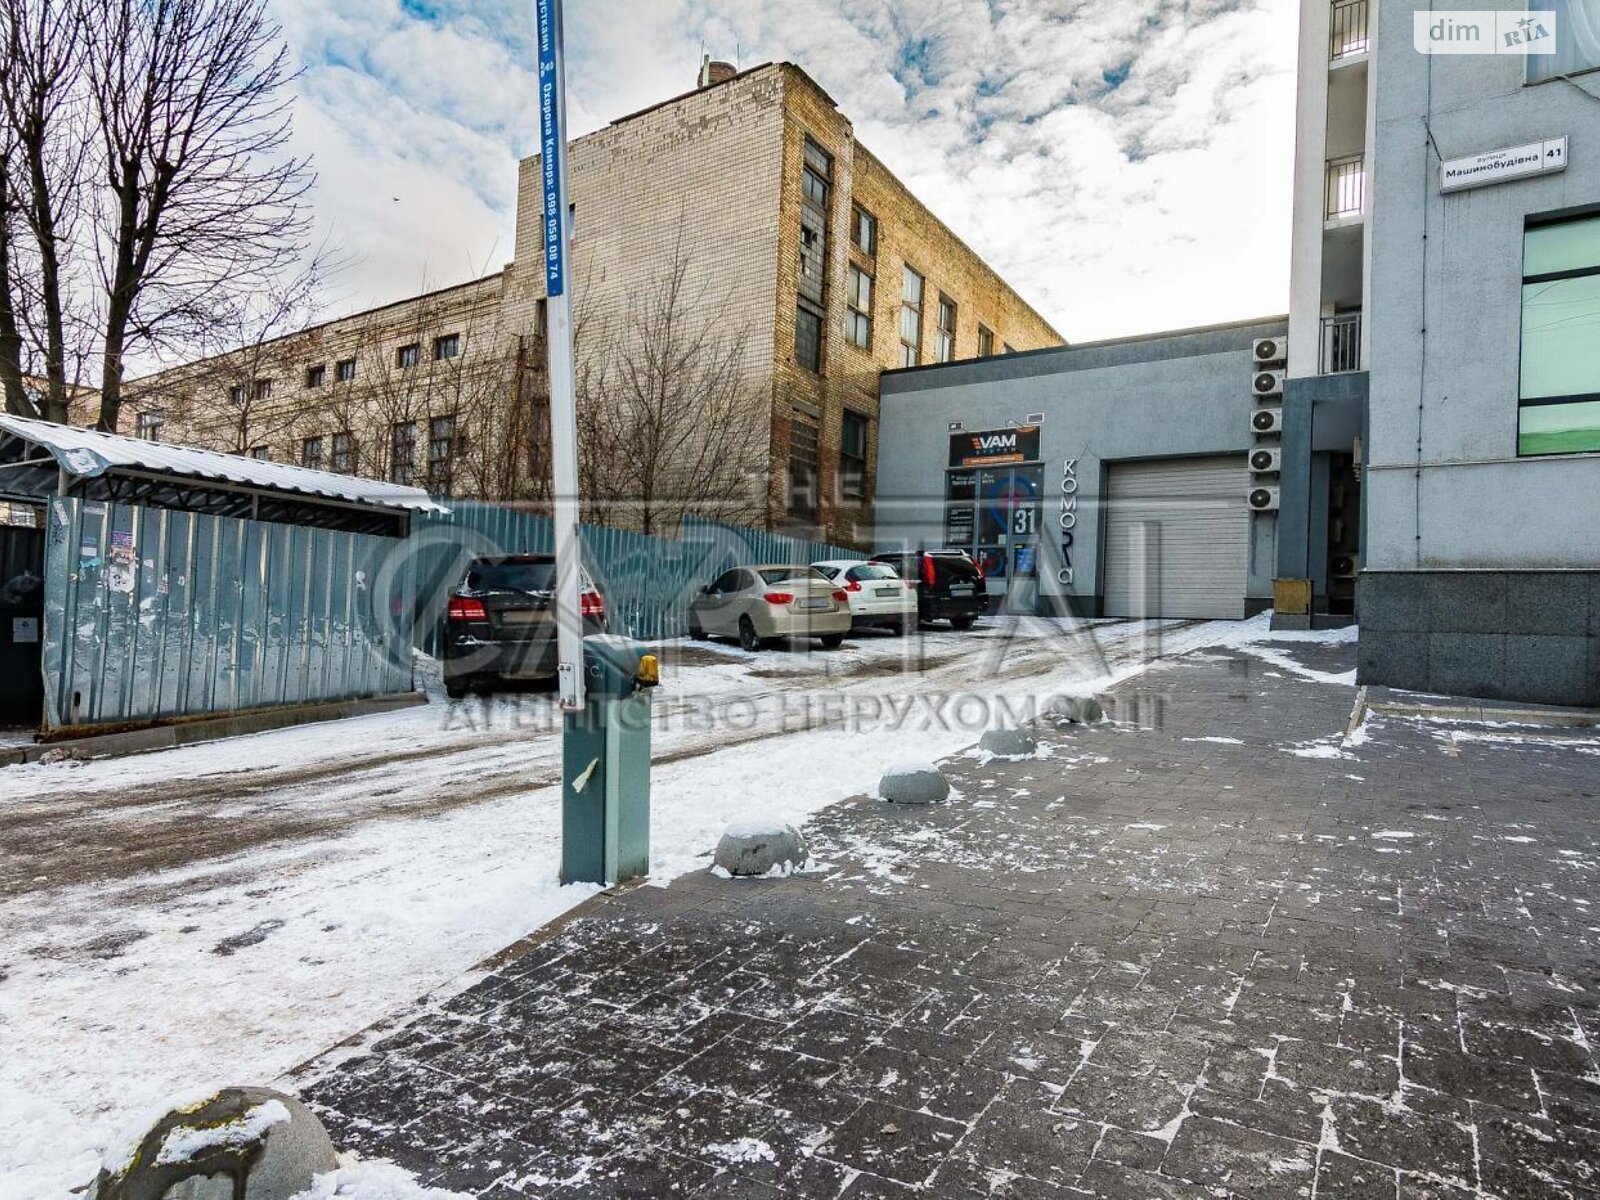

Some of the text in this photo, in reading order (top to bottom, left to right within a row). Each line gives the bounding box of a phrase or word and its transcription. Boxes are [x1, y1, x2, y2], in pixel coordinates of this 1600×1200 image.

[1445, 148, 1562, 178] Машинобудівна 41
[543, 83, 558, 280] Охорона Комора: 098 058 08 74
[1015, 510, 1035, 533] 31
